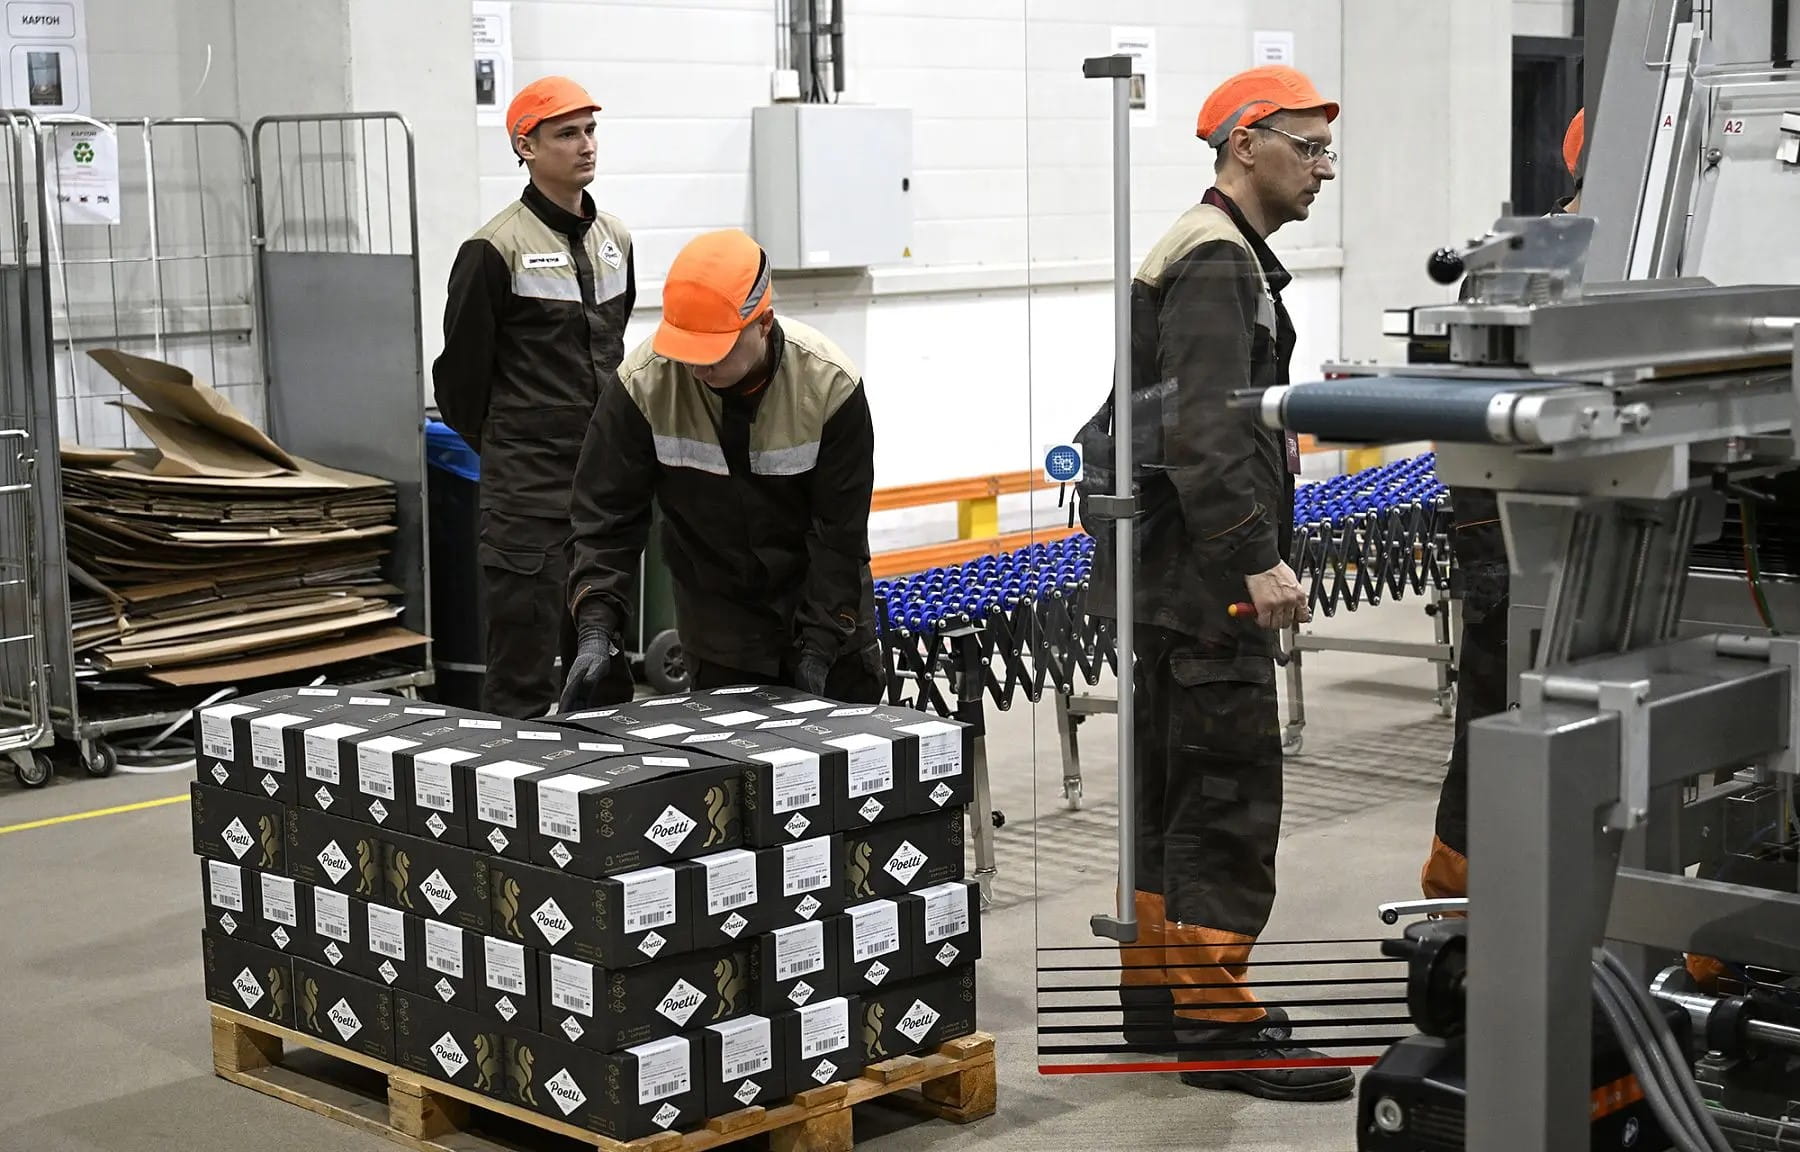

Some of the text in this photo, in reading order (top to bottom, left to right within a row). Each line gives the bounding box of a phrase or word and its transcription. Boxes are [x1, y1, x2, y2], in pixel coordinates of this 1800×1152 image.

[22, 15, 60, 25] КАРТОН
[1663, 115, 1672, 127] A
[1723, 120, 1743, 133] A2
[933, 790, 949, 798] Poetti
[862, 806, 880, 814] Poetti
[652, 820, 689, 839] Poetti
[788, 822, 806, 830] Poetti
[226, 829, 249, 846] Poetti
[322, 852, 346, 870] Poetti
[889, 854, 922, 872] Poetti
[424, 882, 452, 901] Poetti
[798, 903, 817, 912] Poetti
[536, 911, 566, 931] Poetti
[724, 921, 743, 930] Poetti
[642, 940, 661, 949] Poetti
[938, 950, 956, 960] Poetti
[868, 968, 885, 978] Poetti
[236, 979, 259, 996] Poetti
[792, 988, 810, 999] Poetti
[663, 993, 700, 1013] Poetti
[332, 1009, 357, 1029] Poetti
[902, 1012, 934, 1031] Poetti
[435, 1044, 463, 1064] Poetti
[815, 1067, 833, 1077] Poetti
[550, 1081, 580, 1102] Poetti
[738, 1087, 757, 1098] Poetti
[656, 1111, 676, 1122] Poetti
